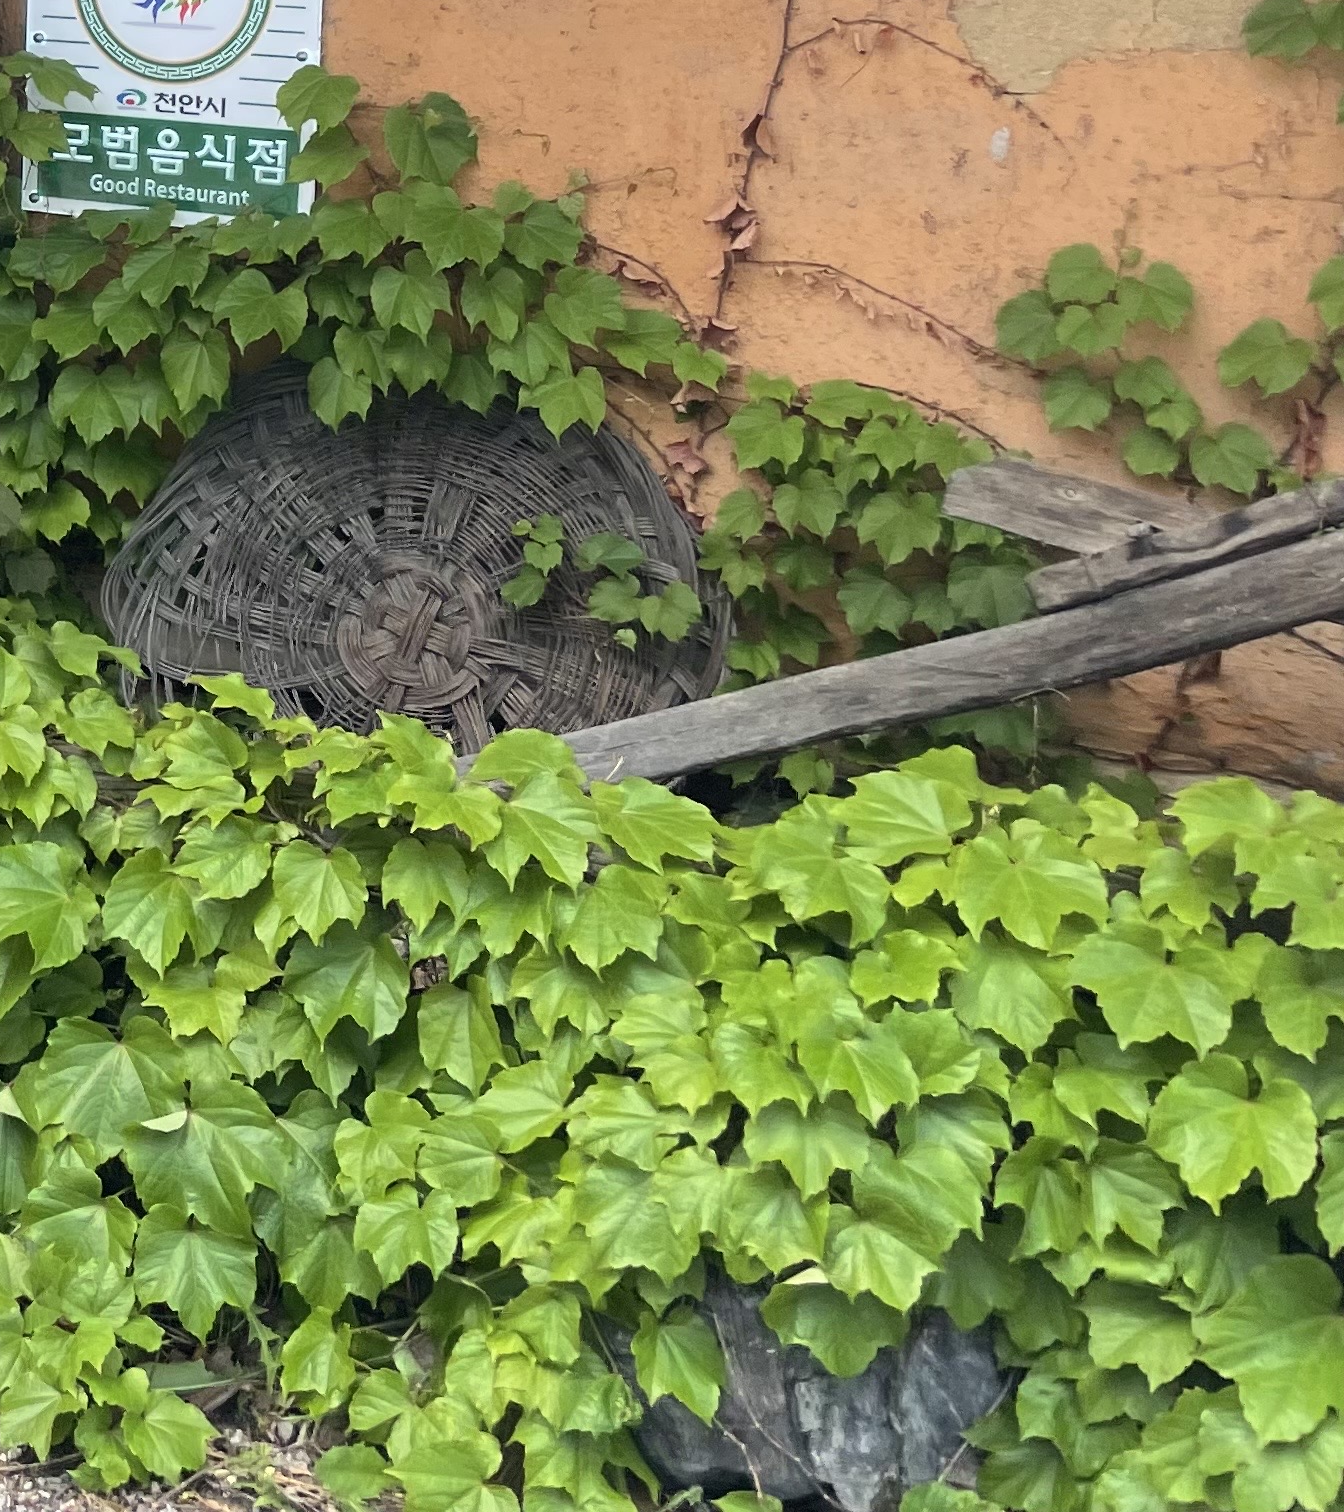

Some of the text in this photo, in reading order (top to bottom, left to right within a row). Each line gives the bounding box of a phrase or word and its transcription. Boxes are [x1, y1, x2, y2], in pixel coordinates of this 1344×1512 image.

[154, 91, 226, 117] 천안시
[89, 173, 250, 207] Good Restaurant
